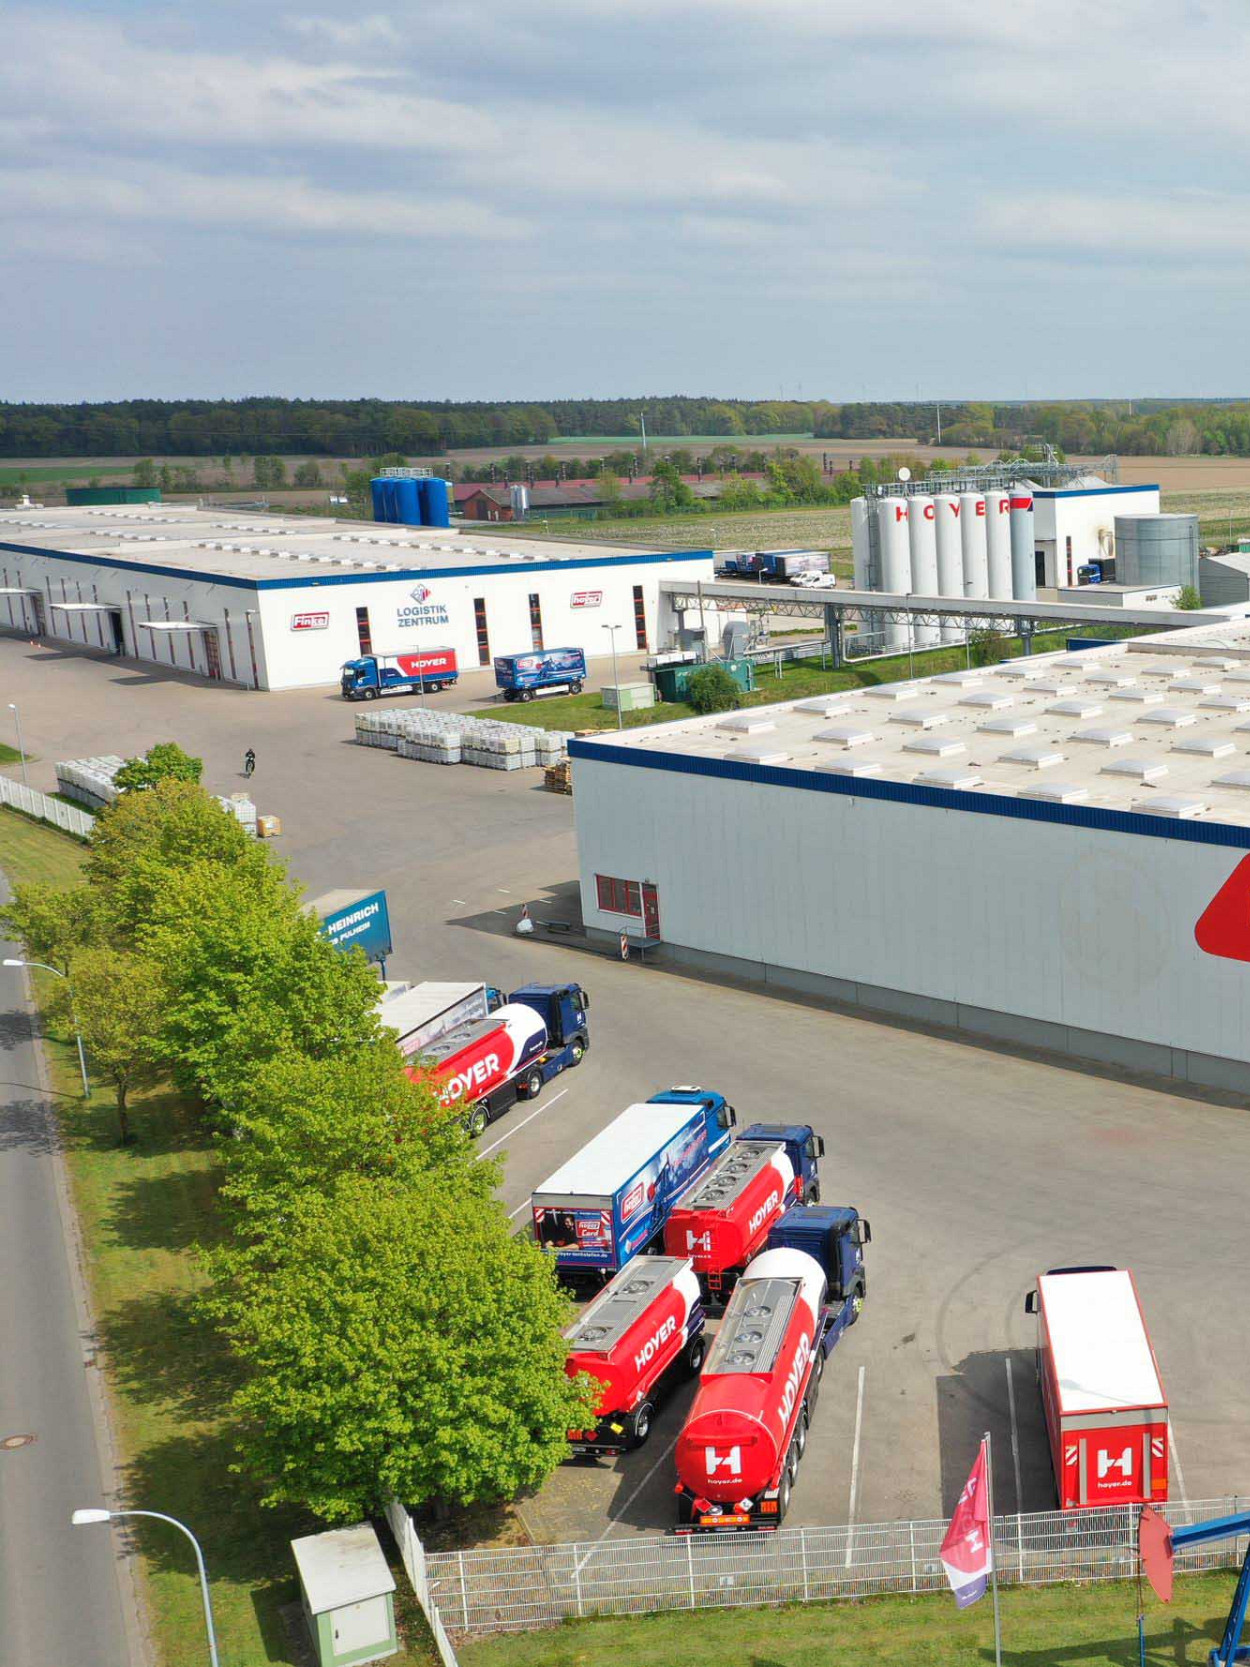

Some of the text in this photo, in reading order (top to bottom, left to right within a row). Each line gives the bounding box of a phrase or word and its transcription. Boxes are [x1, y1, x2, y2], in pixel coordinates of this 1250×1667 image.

[895, 499, 1010, 523] HOYER
[396, 604, 447, 618] LOGISTIK
[398, 615, 449, 628] ZENTRUM
[410, 657, 447, 669] HOYER
[327, 902, 379, 935] HEINRICH
[748, 1189, 779, 1235] HOYER
[633, 1315, 677, 1373] HOYER
[777, 1331, 810, 1432] HOYER
[707, 1477, 743, 1486] hoyer.de
[1097, 1479, 1133, 1489] hoyer.de
